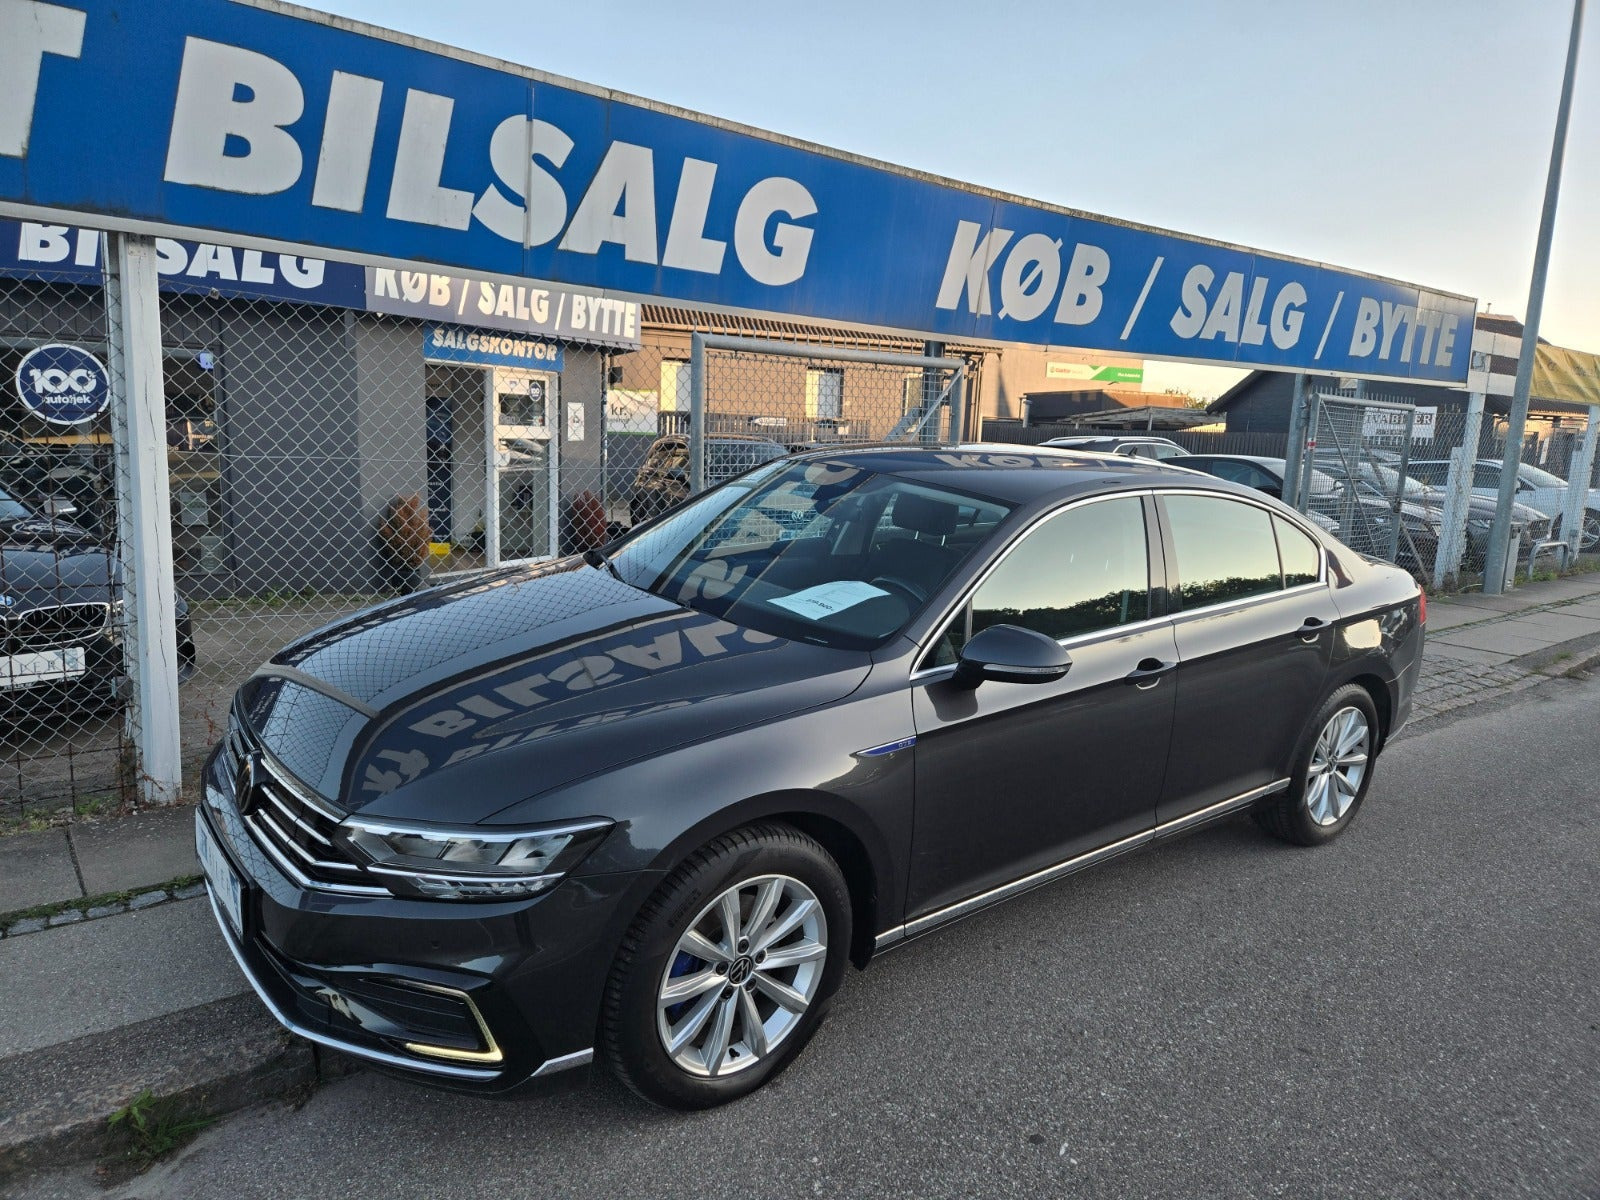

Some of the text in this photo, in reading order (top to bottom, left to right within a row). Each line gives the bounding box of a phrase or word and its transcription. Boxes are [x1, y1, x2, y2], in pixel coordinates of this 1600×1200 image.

[164, 36, 819, 287] BILSALG
[18, 221, 326, 289] BISALG
[374, 267, 451, 307] KØB
[477, 281, 550, 325] SALG
[571, 294, 637, 339] BYTTE
[935, 220, 1111, 326] KØB
[1170, 264, 1307, 351] SALG
[1348, 297, 1459, 368] BYTTE
[432, 328, 557, 361] SALGSKONTOR
